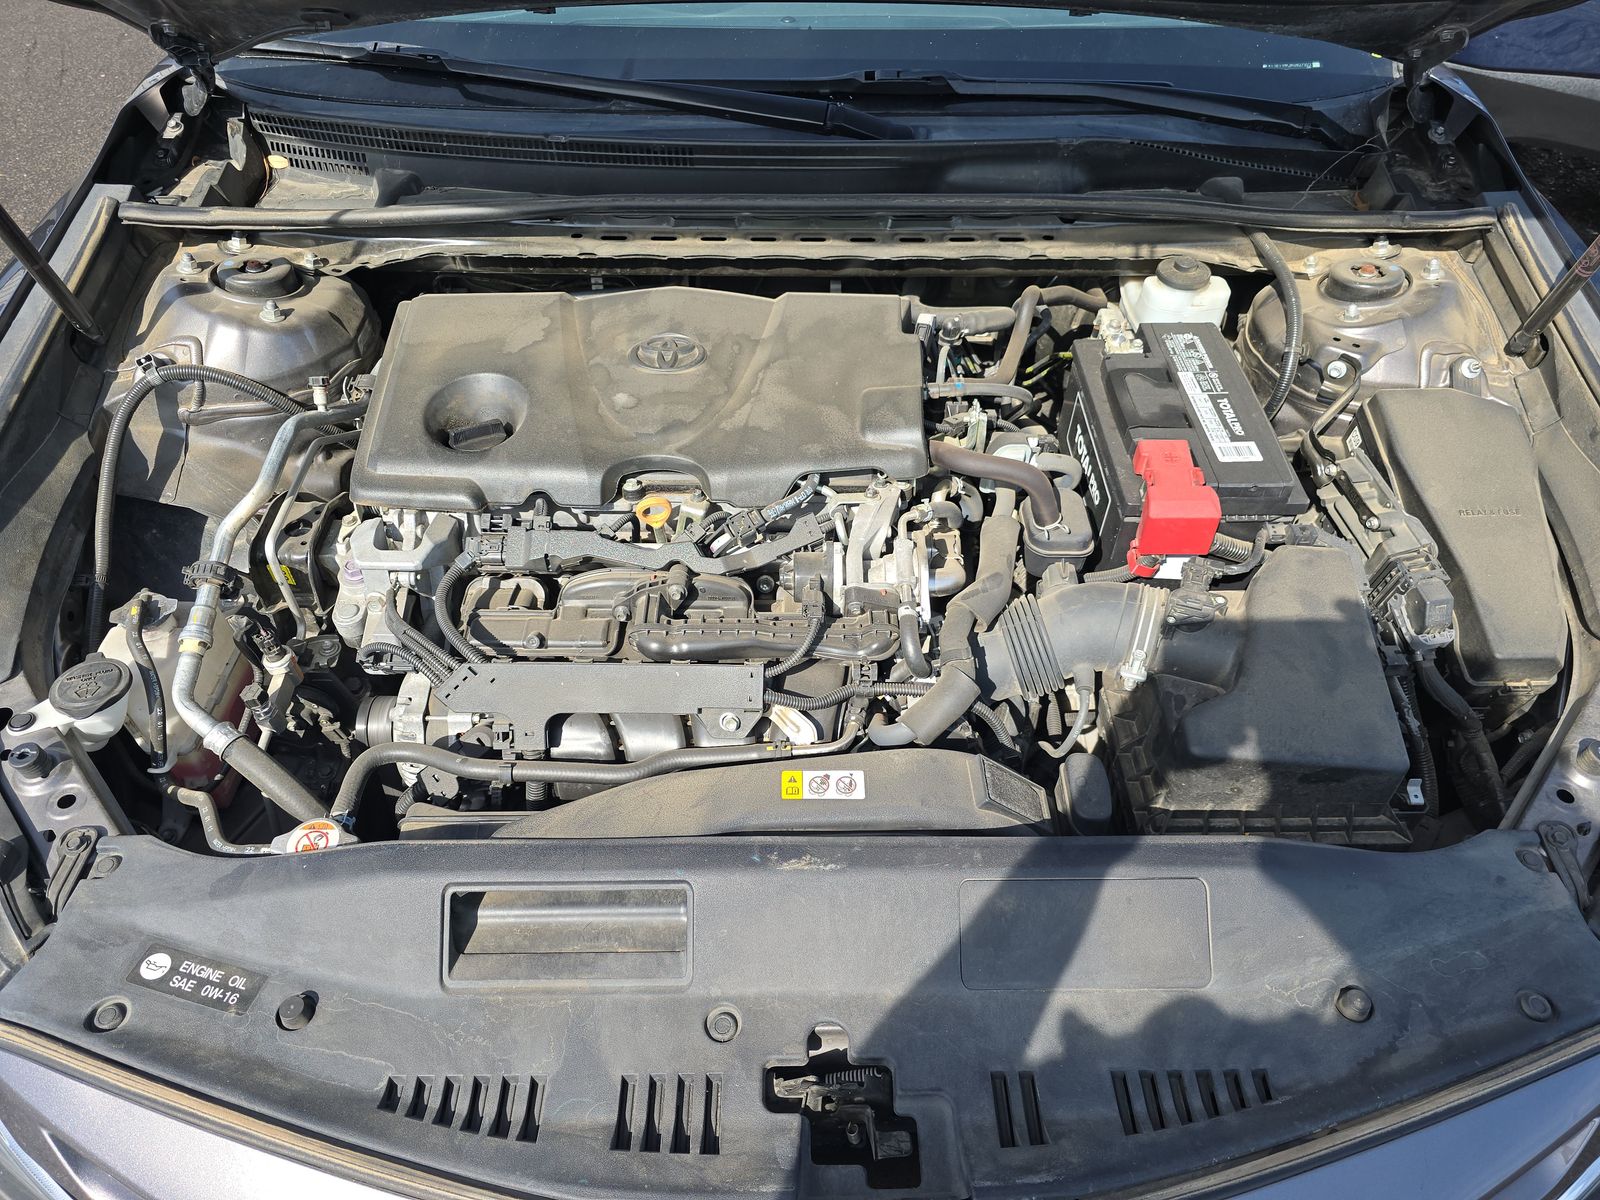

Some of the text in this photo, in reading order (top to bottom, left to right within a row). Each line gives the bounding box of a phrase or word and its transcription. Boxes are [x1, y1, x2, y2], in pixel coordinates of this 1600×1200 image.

[1216, 397, 1246, 437] TOTALPRO
[1458, 508, 1487, 517] RELAY
[169, 975, 240, 1005] SAE 0W-16
[179, 960, 247, 990] ENGINE OIL
